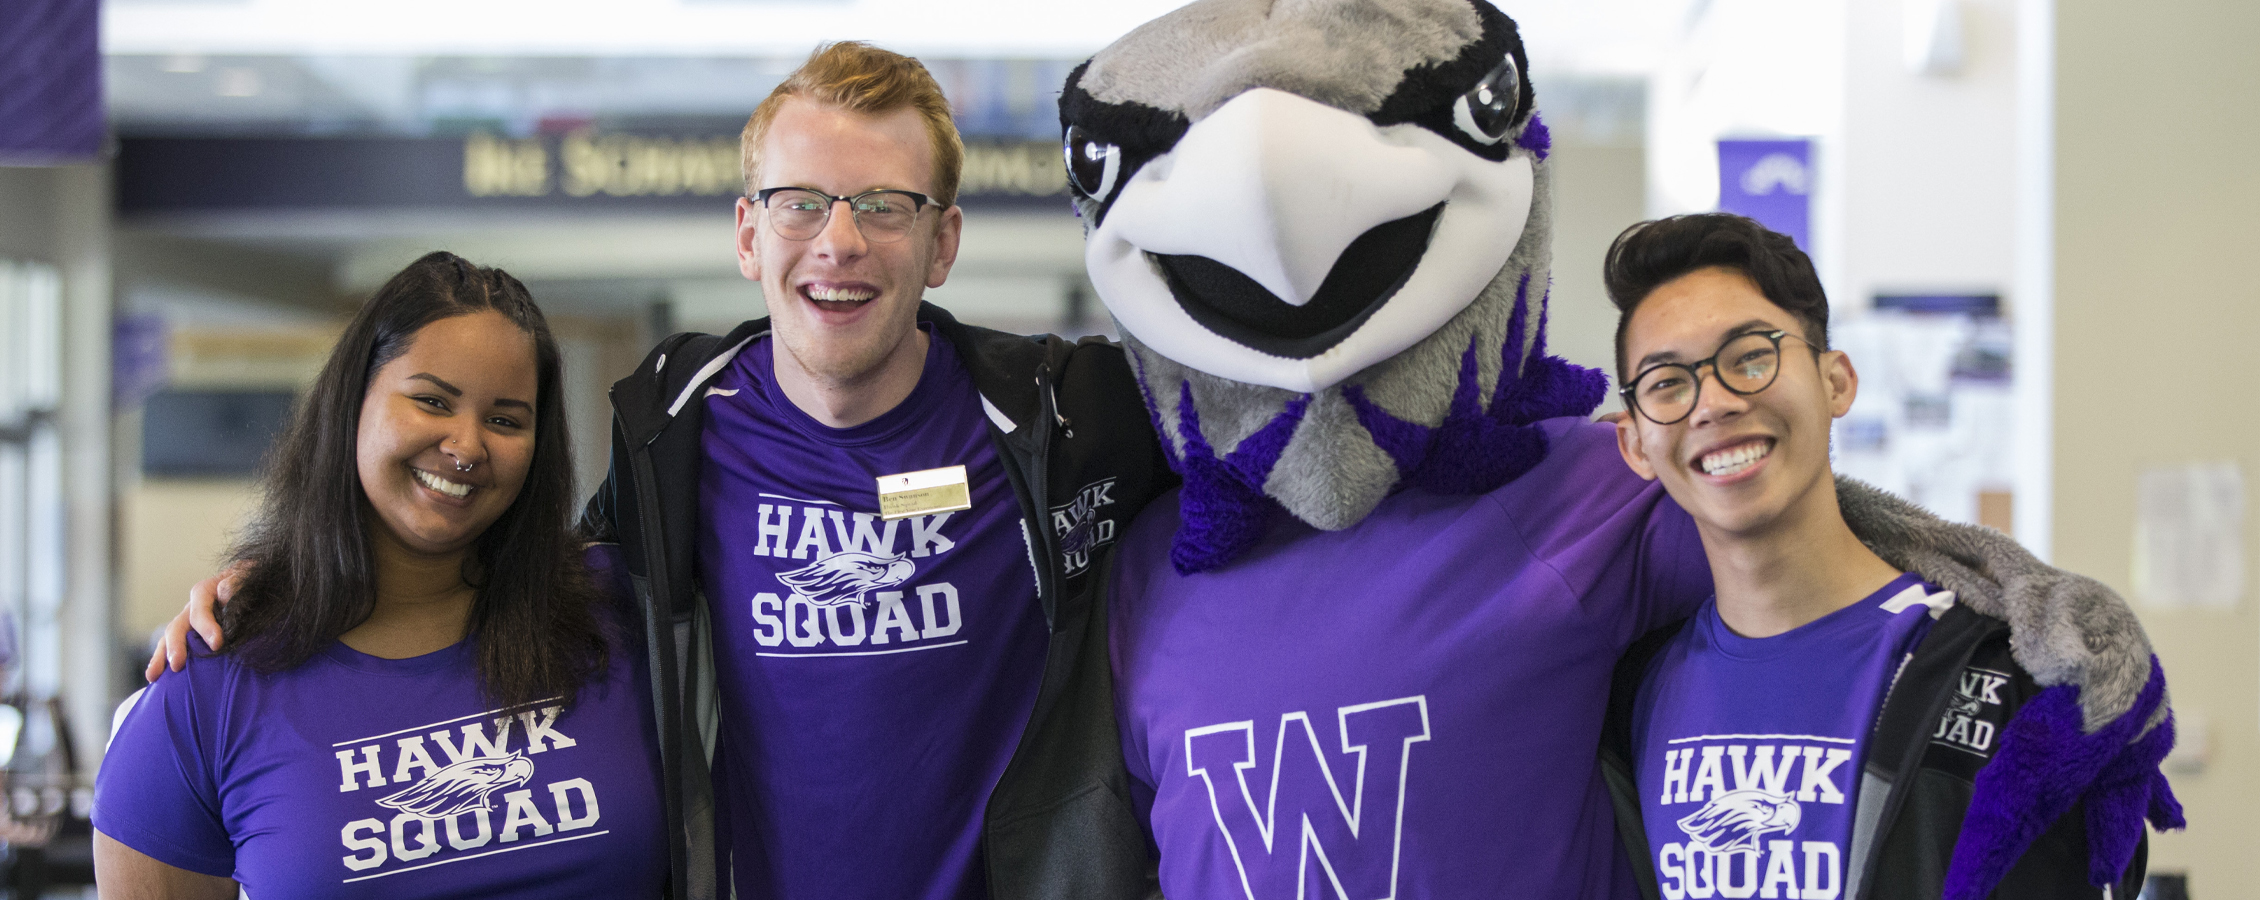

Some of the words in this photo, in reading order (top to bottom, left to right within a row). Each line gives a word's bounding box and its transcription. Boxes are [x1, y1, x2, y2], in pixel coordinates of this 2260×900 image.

[754, 503, 956, 558] HAWK
[1051, 481, 1115, 536] AWK
[751, 582, 963, 648] SQUAD
[335, 705, 577, 793] HAWK
[1660, 745, 1852, 805] HAWK
[341, 777, 600, 872] SQUAD
[1184, 694, 1431, 900] W
[1659, 840, 1841, 900] SQUAD
